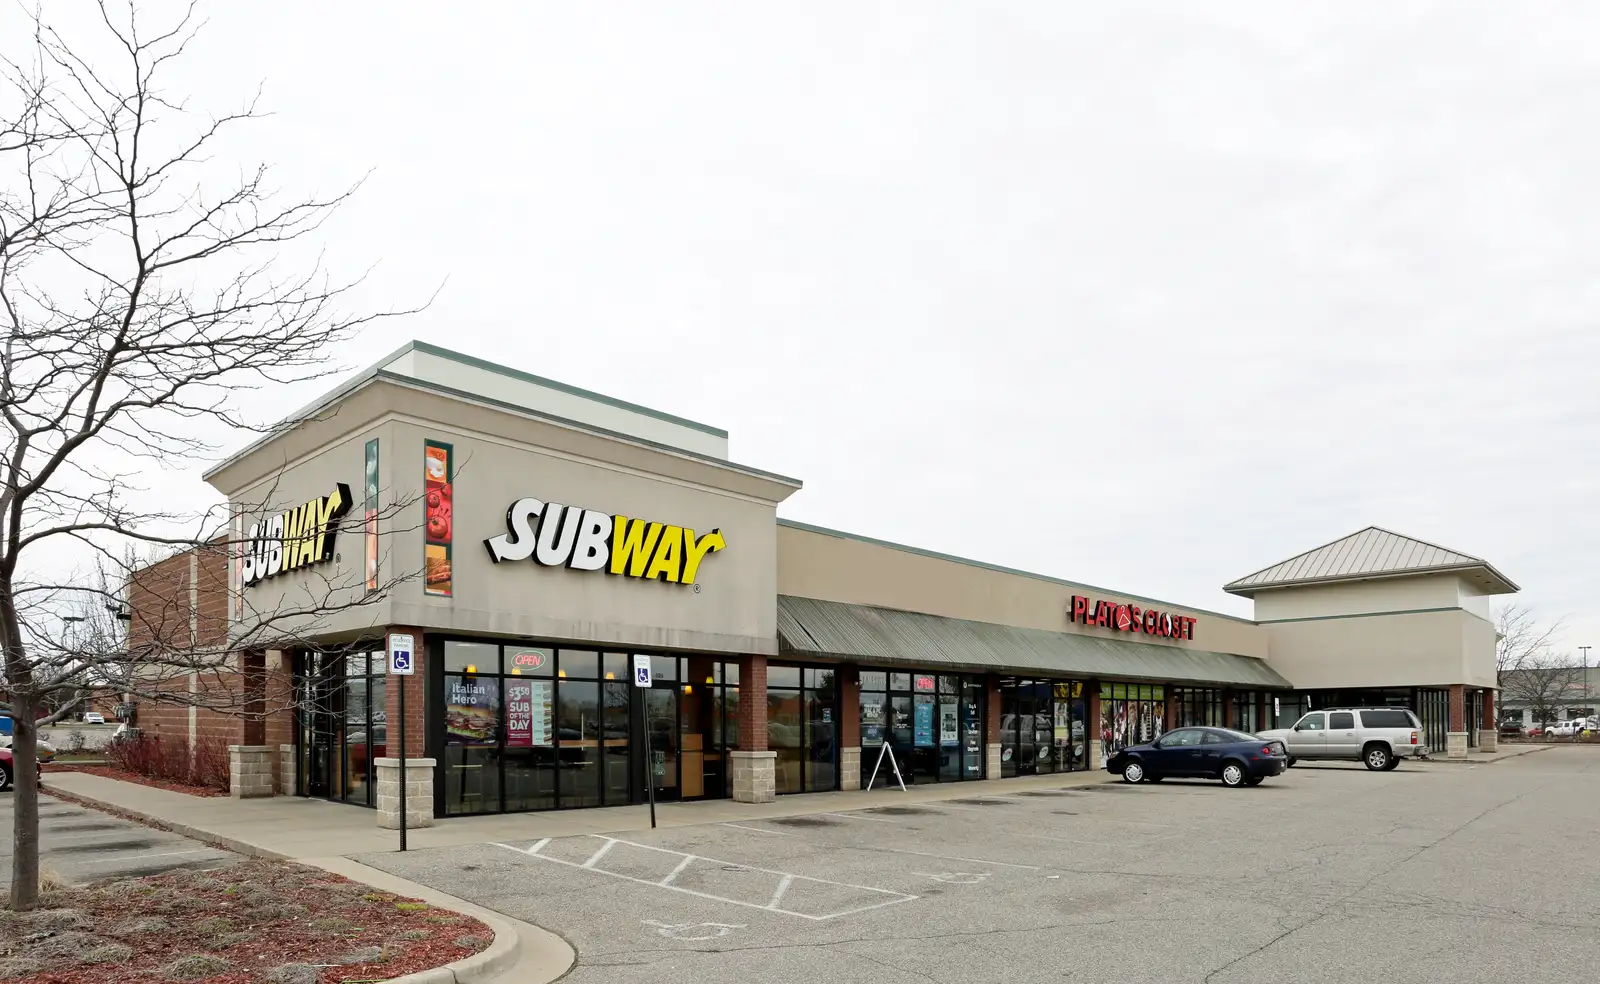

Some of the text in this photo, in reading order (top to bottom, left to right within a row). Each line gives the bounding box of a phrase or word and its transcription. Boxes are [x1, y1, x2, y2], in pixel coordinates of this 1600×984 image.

[242, 483, 352, 587] SUBWAY
[484, 497, 727, 586] SUBWAY
[1071, 595, 1197, 640] PLATO'S CLOSET
[515, 655, 540, 666] OPEN
[452, 683, 485, 694] Italian
[917, 678, 934, 689] OPEN
[452, 694, 477, 704] Hero
[510, 702, 530, 712] SUB
[510, 720, 530, 730] DAY
